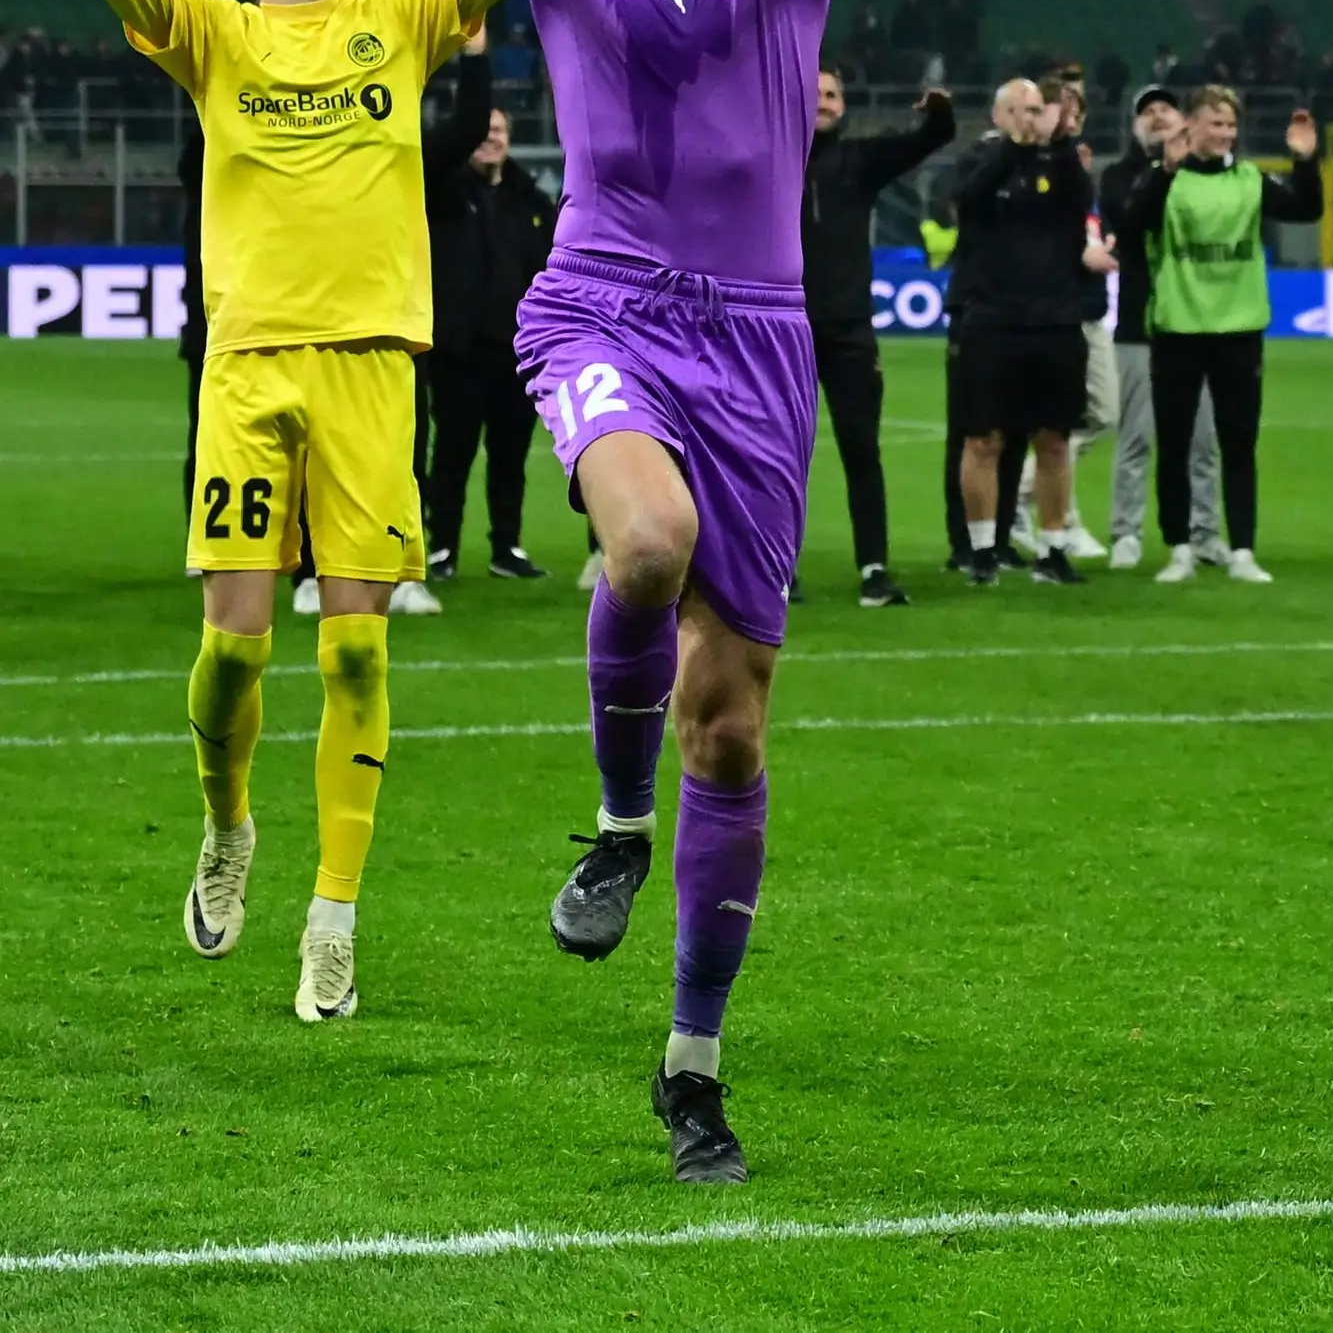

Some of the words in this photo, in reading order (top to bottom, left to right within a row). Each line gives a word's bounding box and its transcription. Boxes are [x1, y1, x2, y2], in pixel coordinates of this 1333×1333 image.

[238, 87, 358, 117] SpareBank
[267, 110, 363, 128] NORD-NORGE
[557, 362, 629, 441] 12
[204, 476, 273, 539] 26
